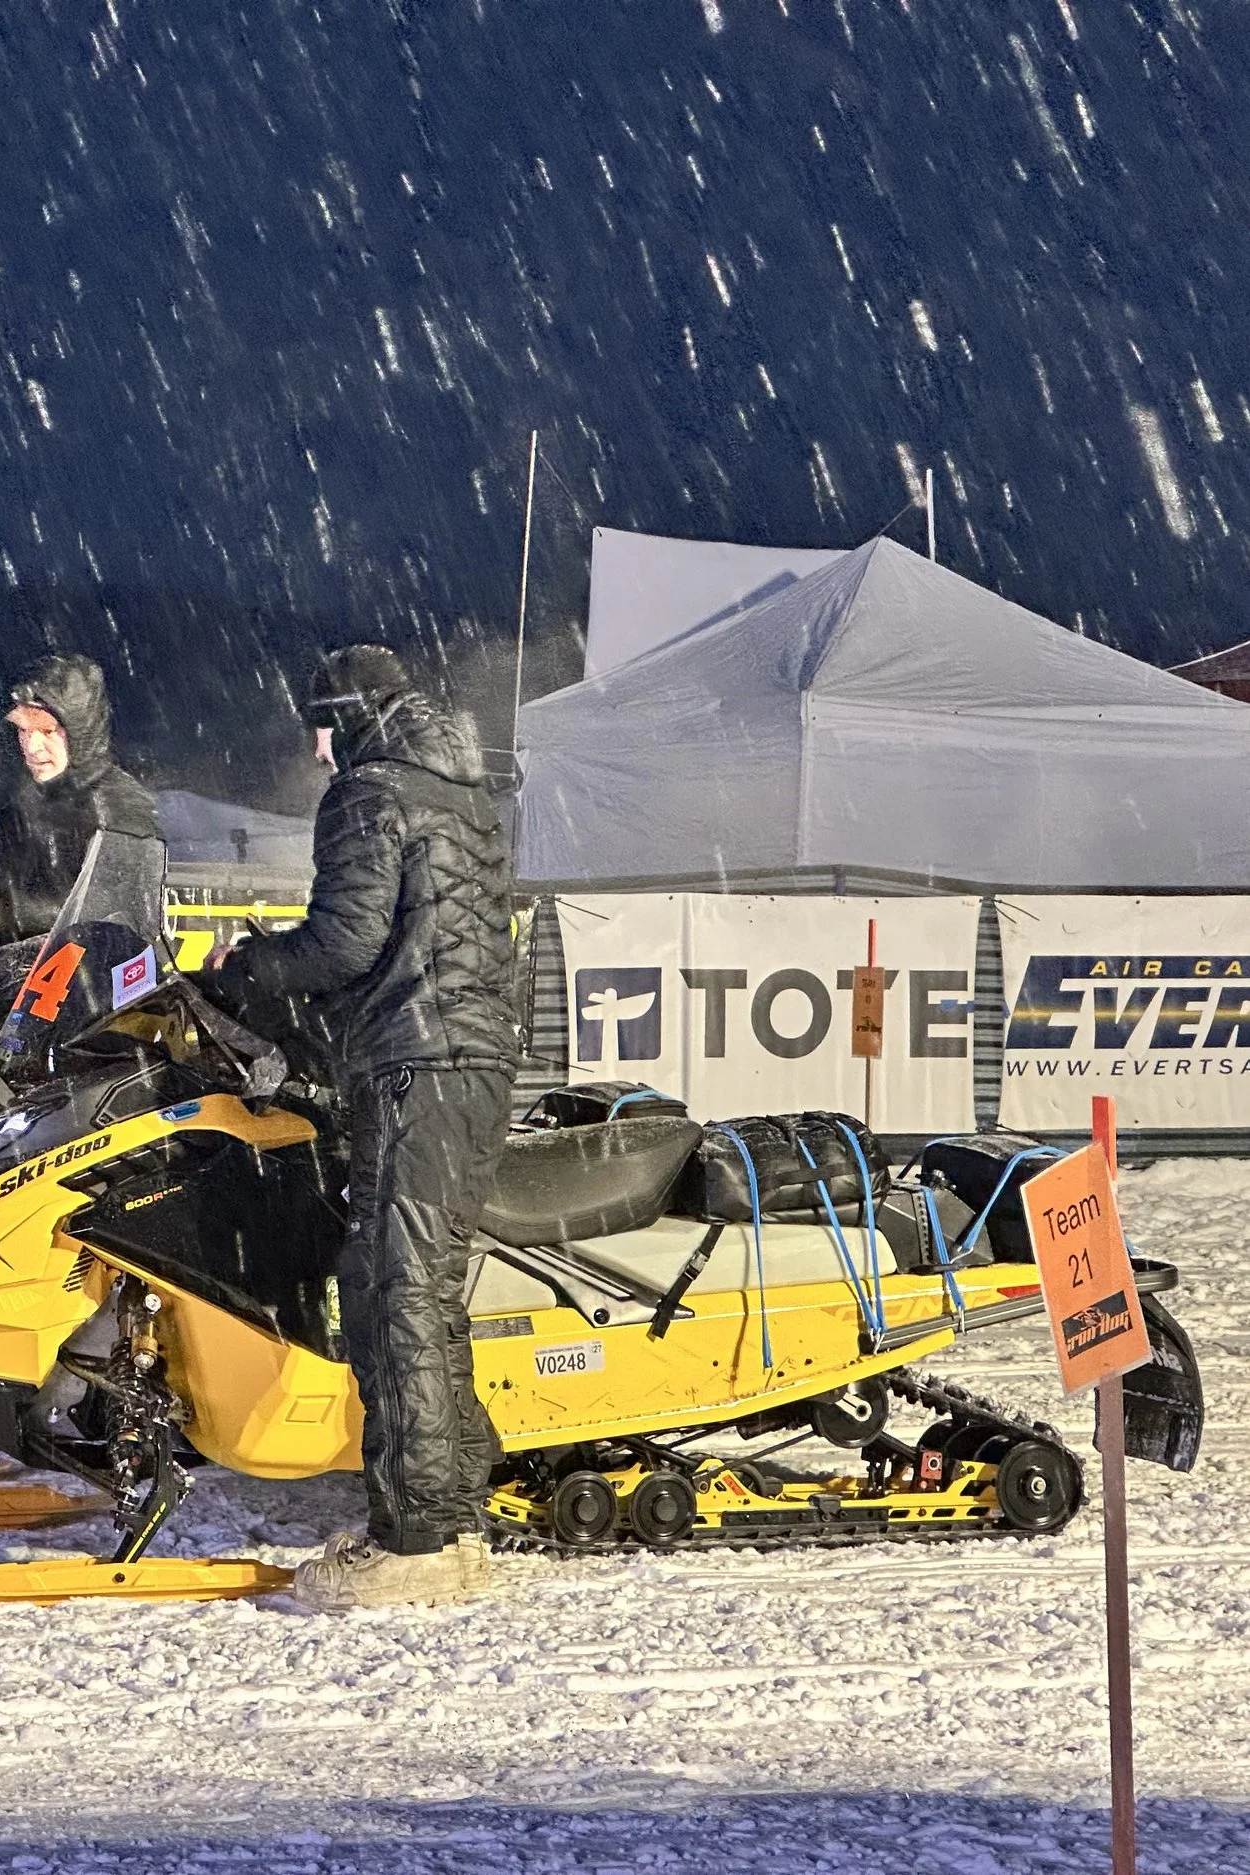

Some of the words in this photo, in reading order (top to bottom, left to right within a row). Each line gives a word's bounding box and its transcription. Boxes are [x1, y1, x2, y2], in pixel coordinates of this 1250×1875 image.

[1089, 960, 1162, 976] AIR
[1194, 960, 1242, 976] CA
[678, 968, 968, 1059] TOE
[1006, 956, 1250, 1049] EVER
[1043, 1193, 1100, 1241] Team
[1068, 1248, 1094, 1289] 21
[535, 1353, 586, 1375] V0248
